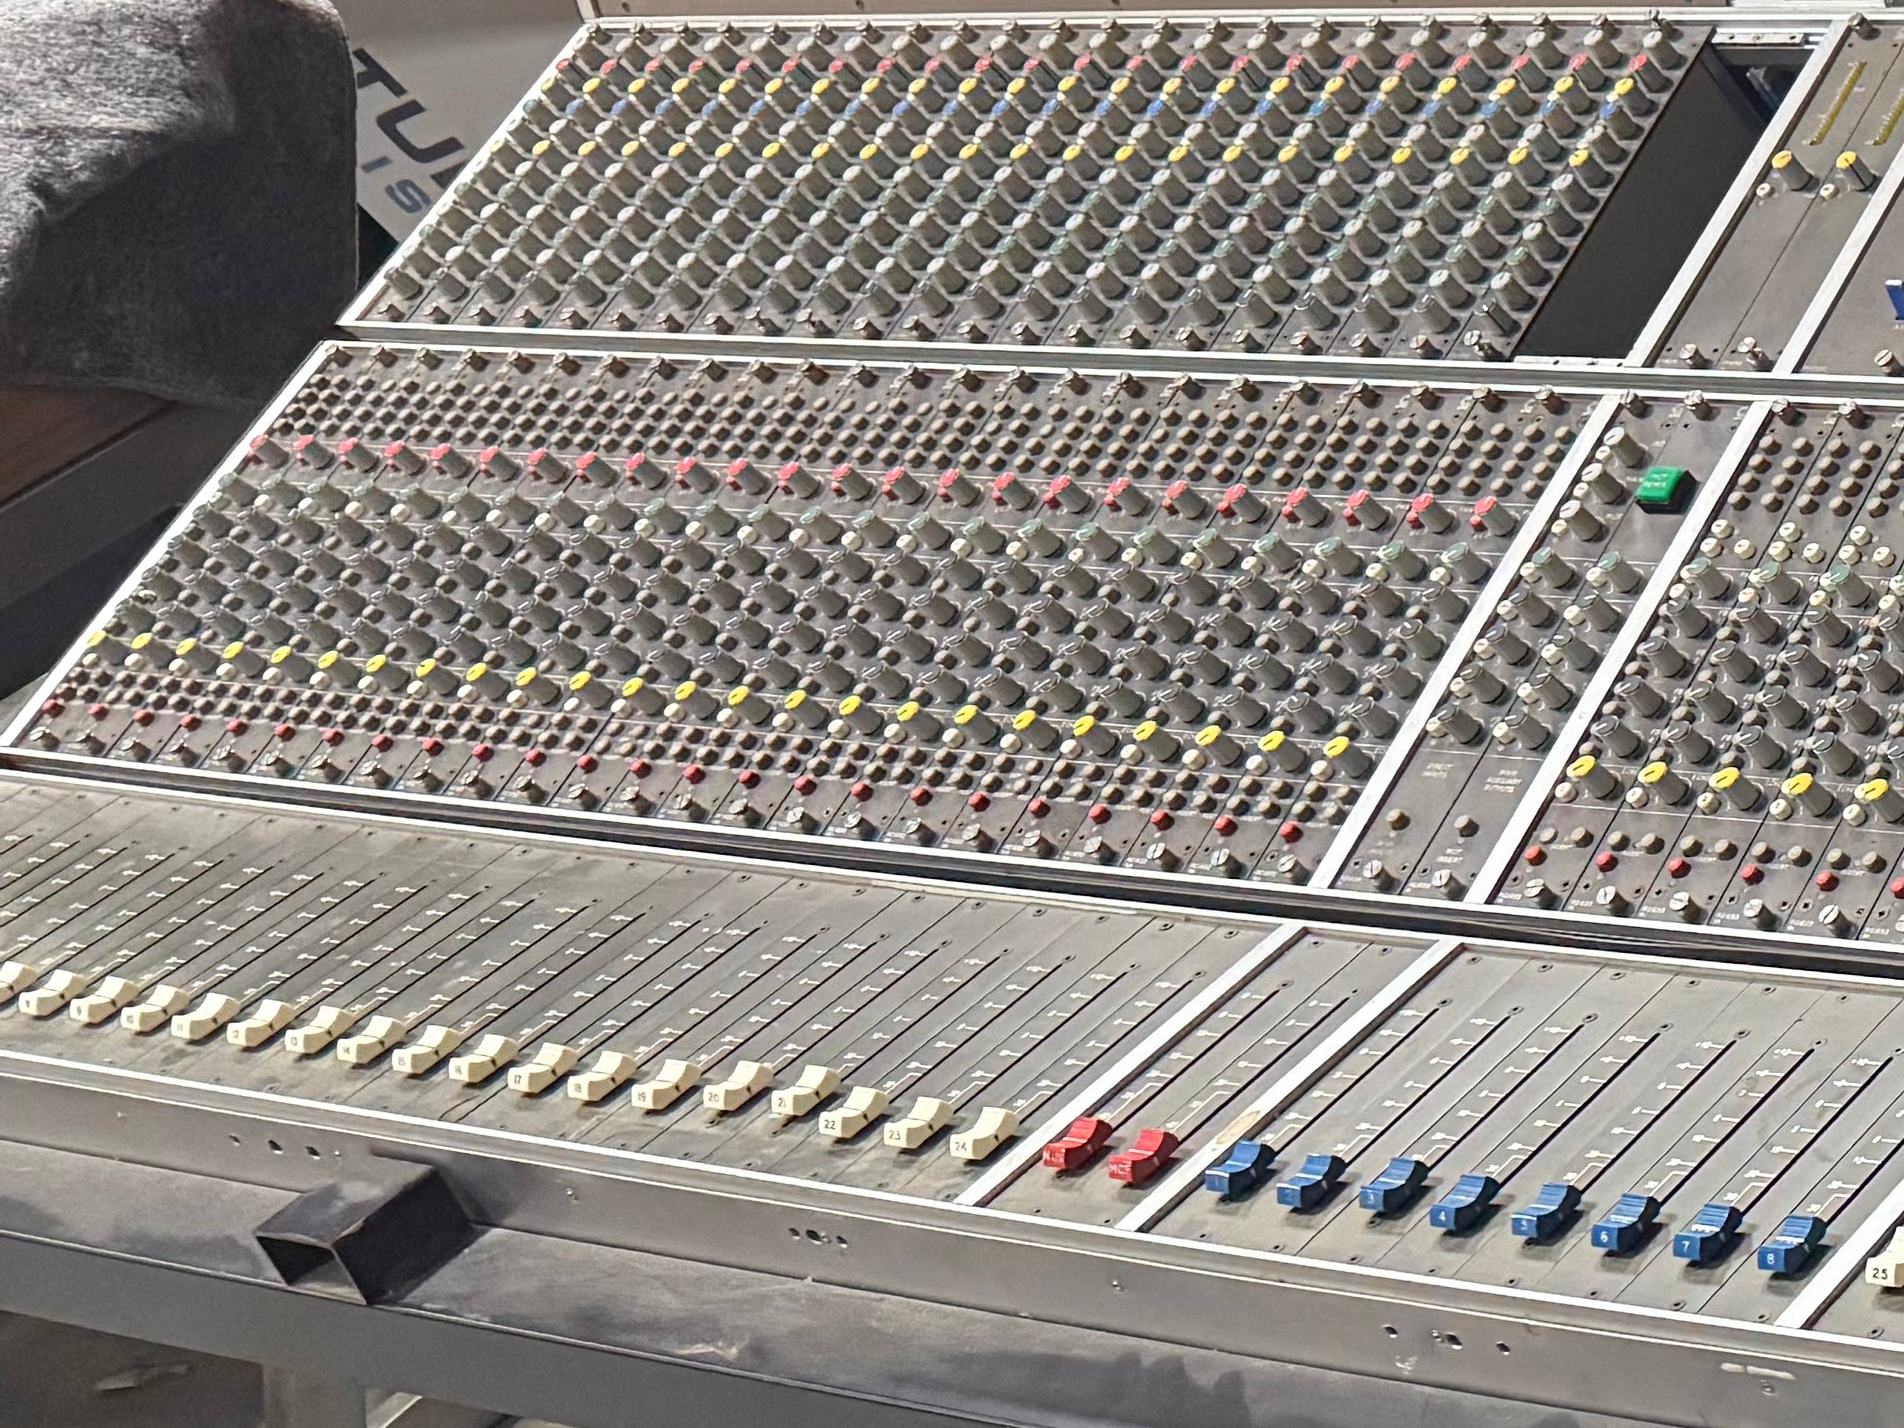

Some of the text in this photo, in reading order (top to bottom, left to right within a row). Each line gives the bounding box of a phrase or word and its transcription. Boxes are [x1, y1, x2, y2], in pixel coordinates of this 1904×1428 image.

[708, 1092, 719, 1101] 20
[825, 1120, 836, 1129] 22
[889, 1130, 901, 1140] 23
[955, 1141, 967, 1152] 24
[1438, 1212, 1448, 1223] 4
[1600, 1231, 1608, 1243] 6
[1681, 1241, 1690, 1252] 7
[1766, 1253, 1775, 1265] 8
[1871, 1266, 1889, 1280] 25
